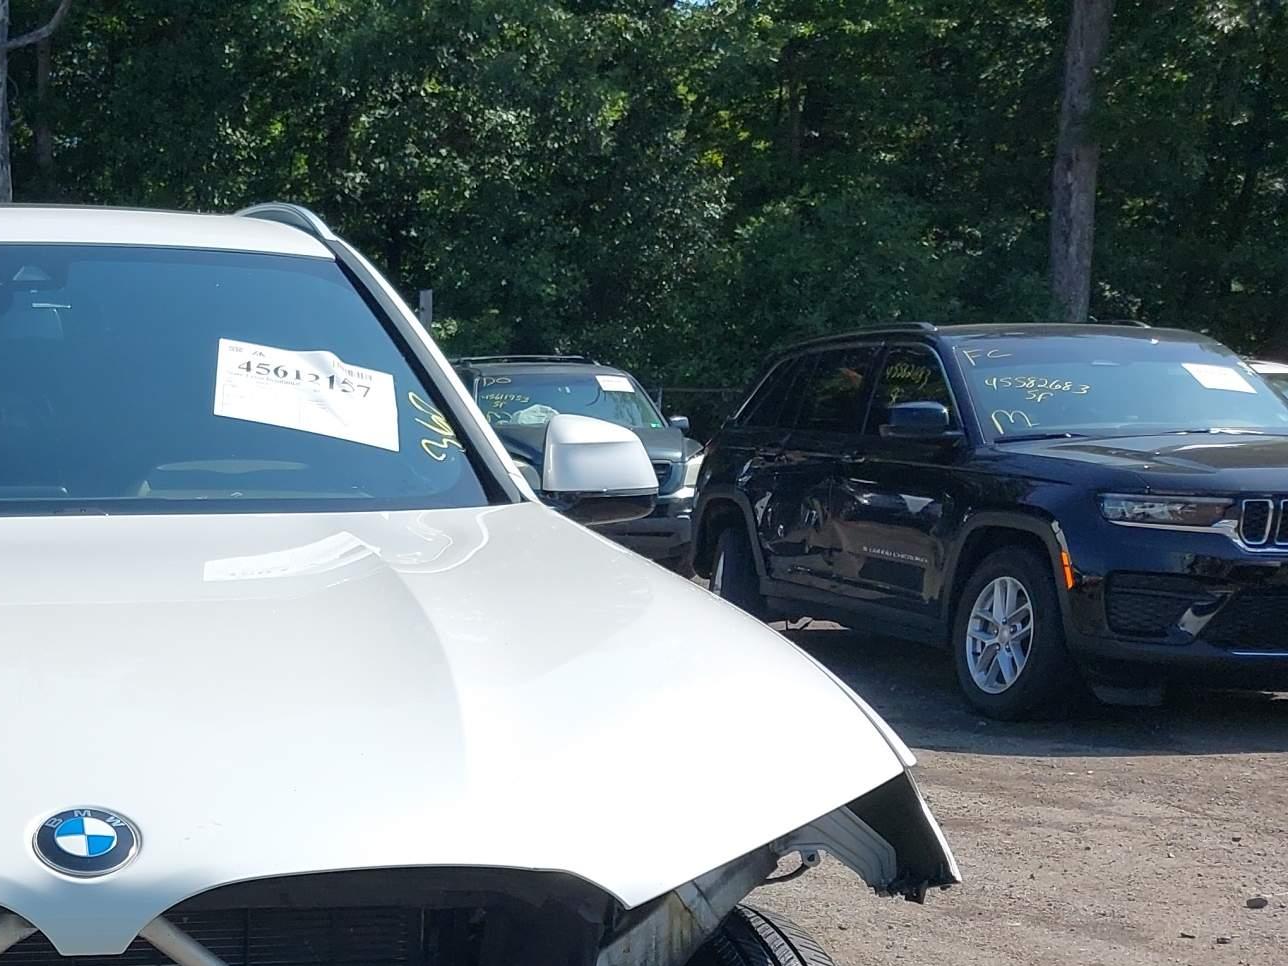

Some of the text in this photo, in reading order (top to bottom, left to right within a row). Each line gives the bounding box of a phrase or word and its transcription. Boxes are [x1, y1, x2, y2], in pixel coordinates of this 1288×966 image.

[962, 349, 1012, 366] FC
[238, 360, 371, 398] 45612157
[483, 377, 512, 387] DO
[984, 377, 1091, 394] 45582683
[44, 809, 126, 829] BMW
